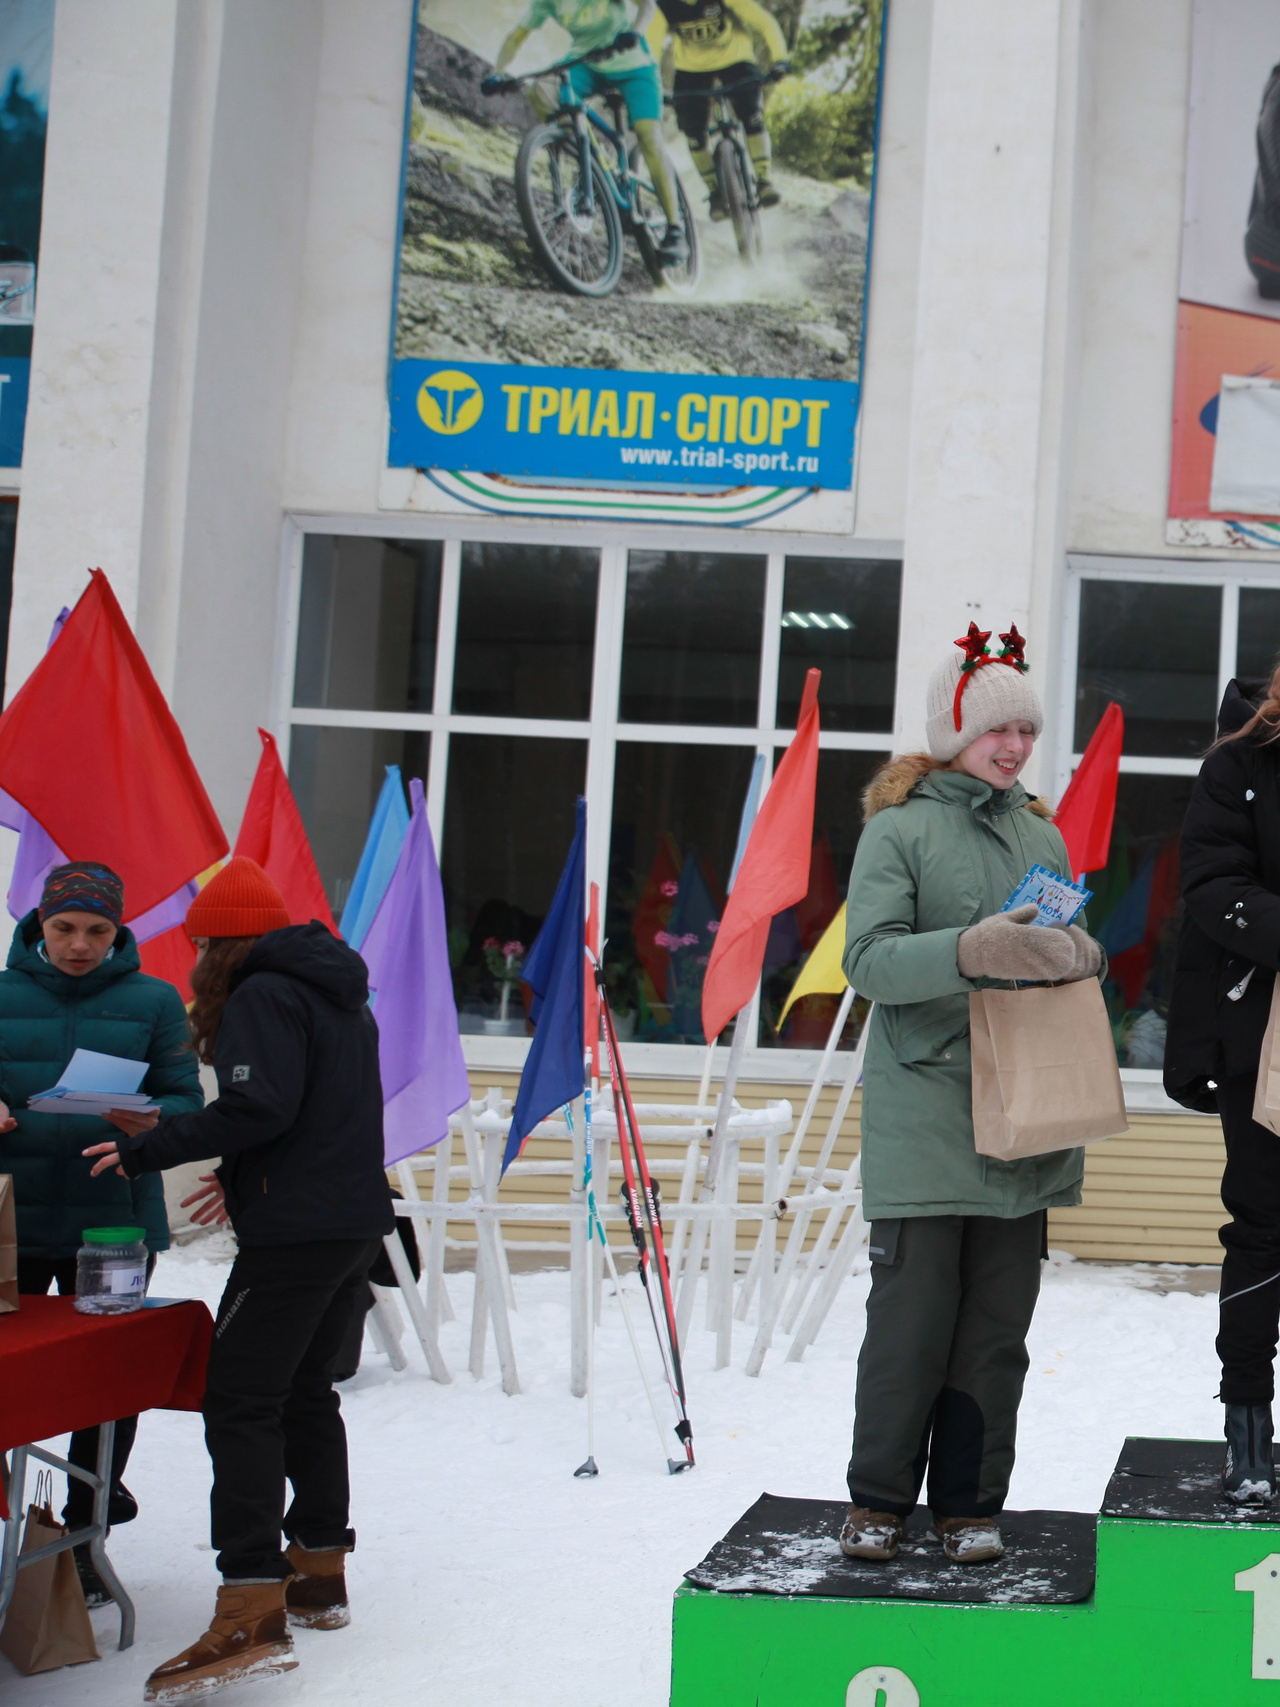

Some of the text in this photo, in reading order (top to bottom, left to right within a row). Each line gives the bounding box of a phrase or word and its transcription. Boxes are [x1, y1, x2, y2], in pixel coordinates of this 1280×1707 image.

[620, 446, 819, 474] www.trial-sport.ru
[629, 1187, 644, 1229] NORDWAY
[646, 1186, 660, 1228] NORDWAY
